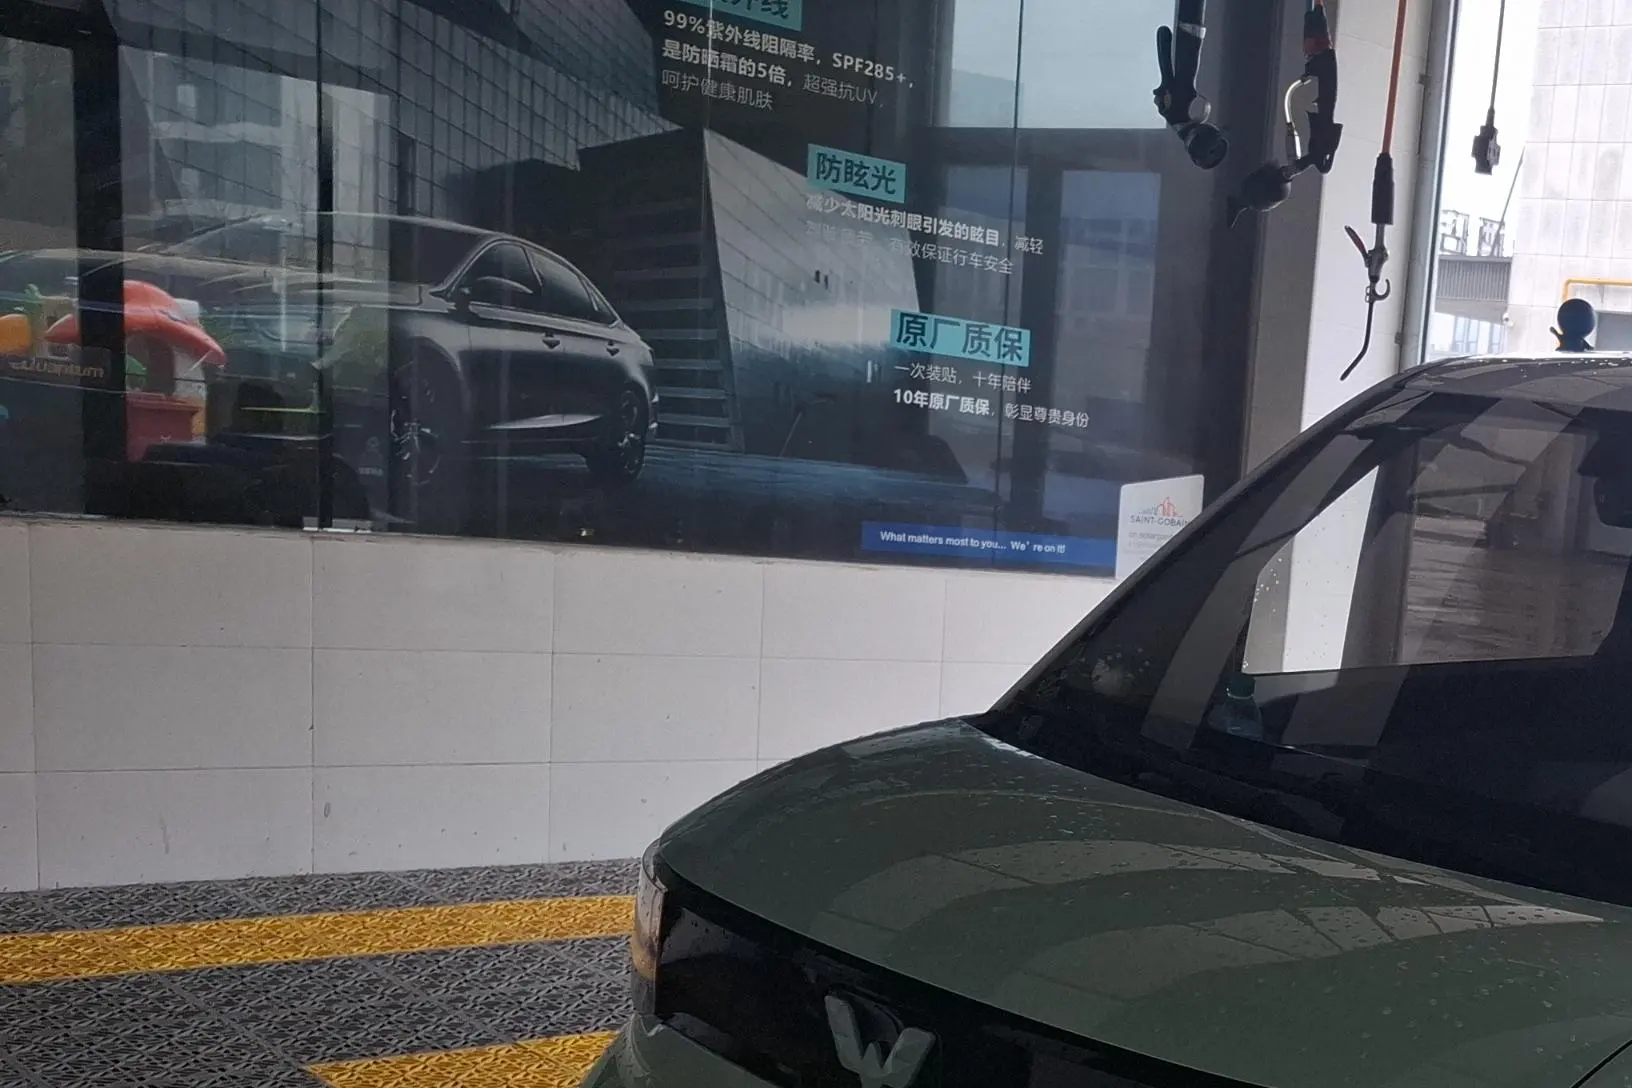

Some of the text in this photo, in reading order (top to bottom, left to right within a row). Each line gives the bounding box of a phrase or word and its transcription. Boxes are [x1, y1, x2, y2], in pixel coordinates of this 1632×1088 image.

[661, 69, 776, 111] 呵护健康肌肤
[815, 151, 898, 195] 防眩光
[896, 311, 1023, 362] 原厂质保
[880, 530, 906, 542] What
[907, 533, 944, 545] matters
[945, 536, 969, 547] most
[970, 537, 980, 548] to
[1043, 543, 1056, 553] on
